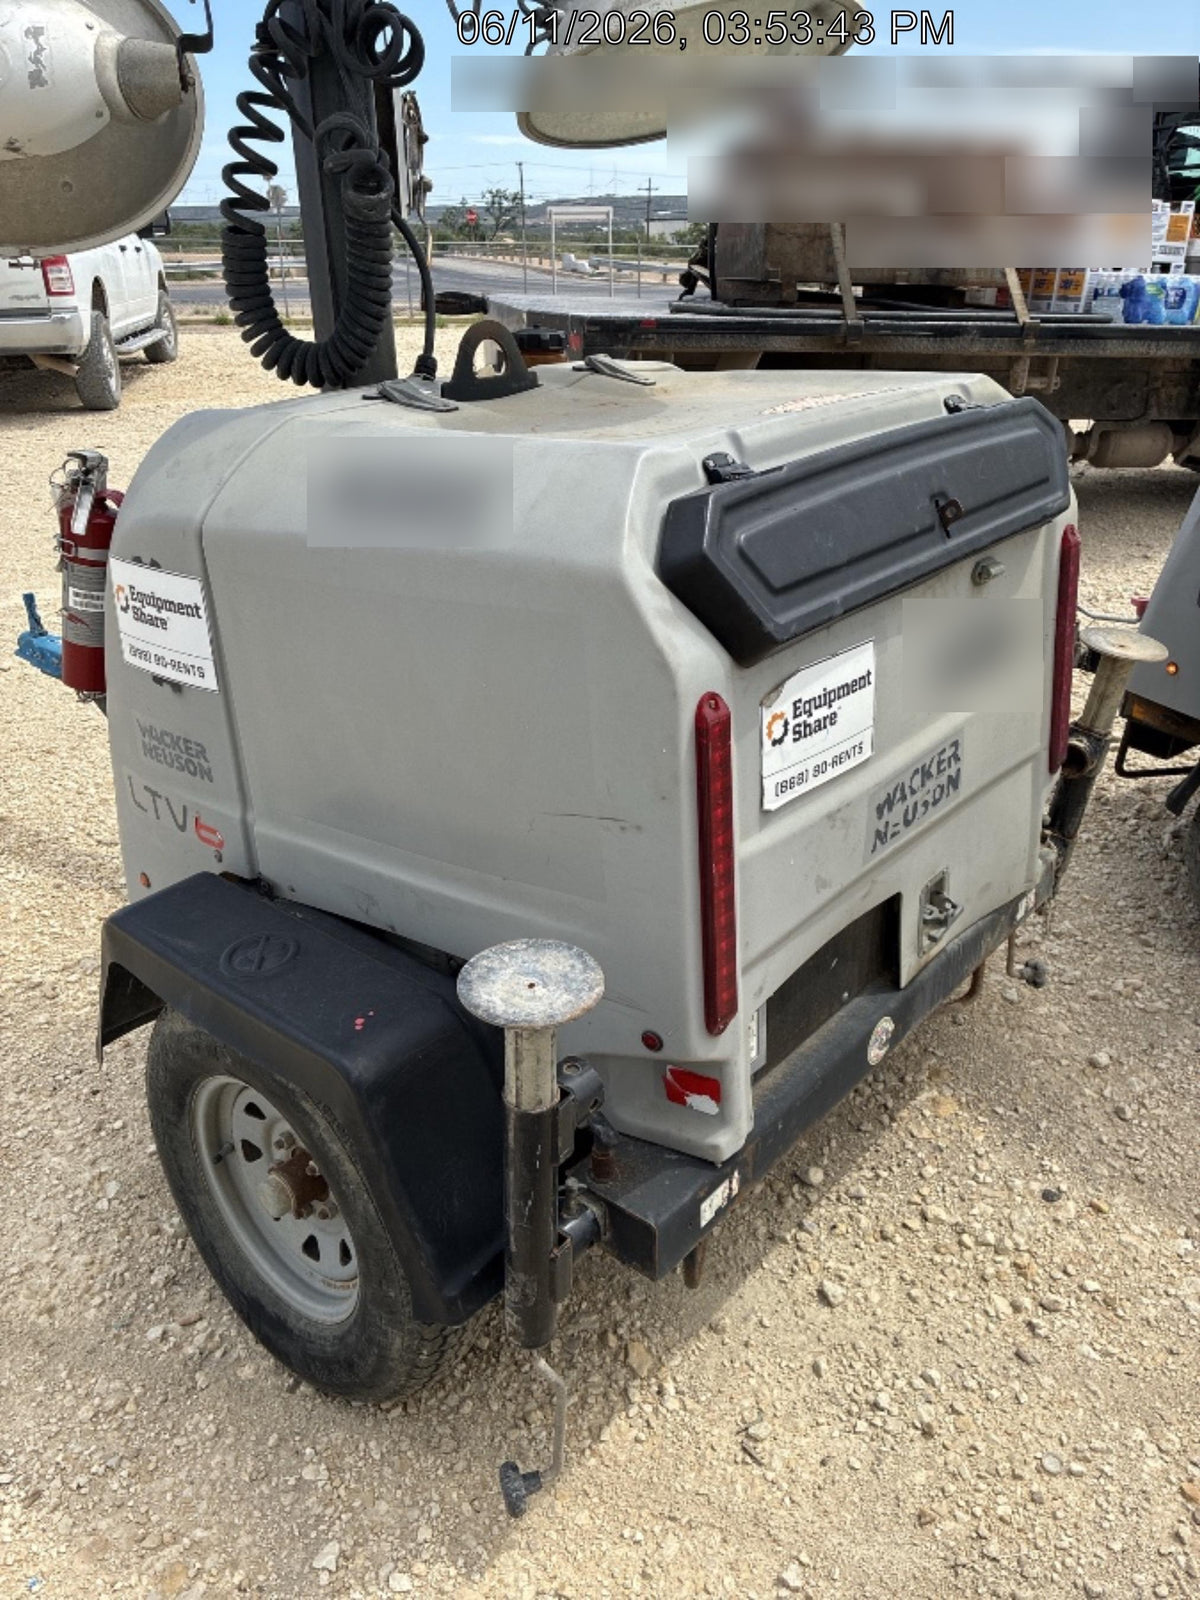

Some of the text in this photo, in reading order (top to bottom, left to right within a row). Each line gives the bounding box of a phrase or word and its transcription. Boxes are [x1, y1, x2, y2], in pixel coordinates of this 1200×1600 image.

[129, 584, 202, 619] Equipment
[131, 605, 168, 631] Share
[792, 669, 872, 719] Equipment
[136, 718, 210, 763] WACKER
[792, 710, 838, 743] Share
[141, 739, 214, 783] NEUSON
[876, 739, 961, 820] WACKER
